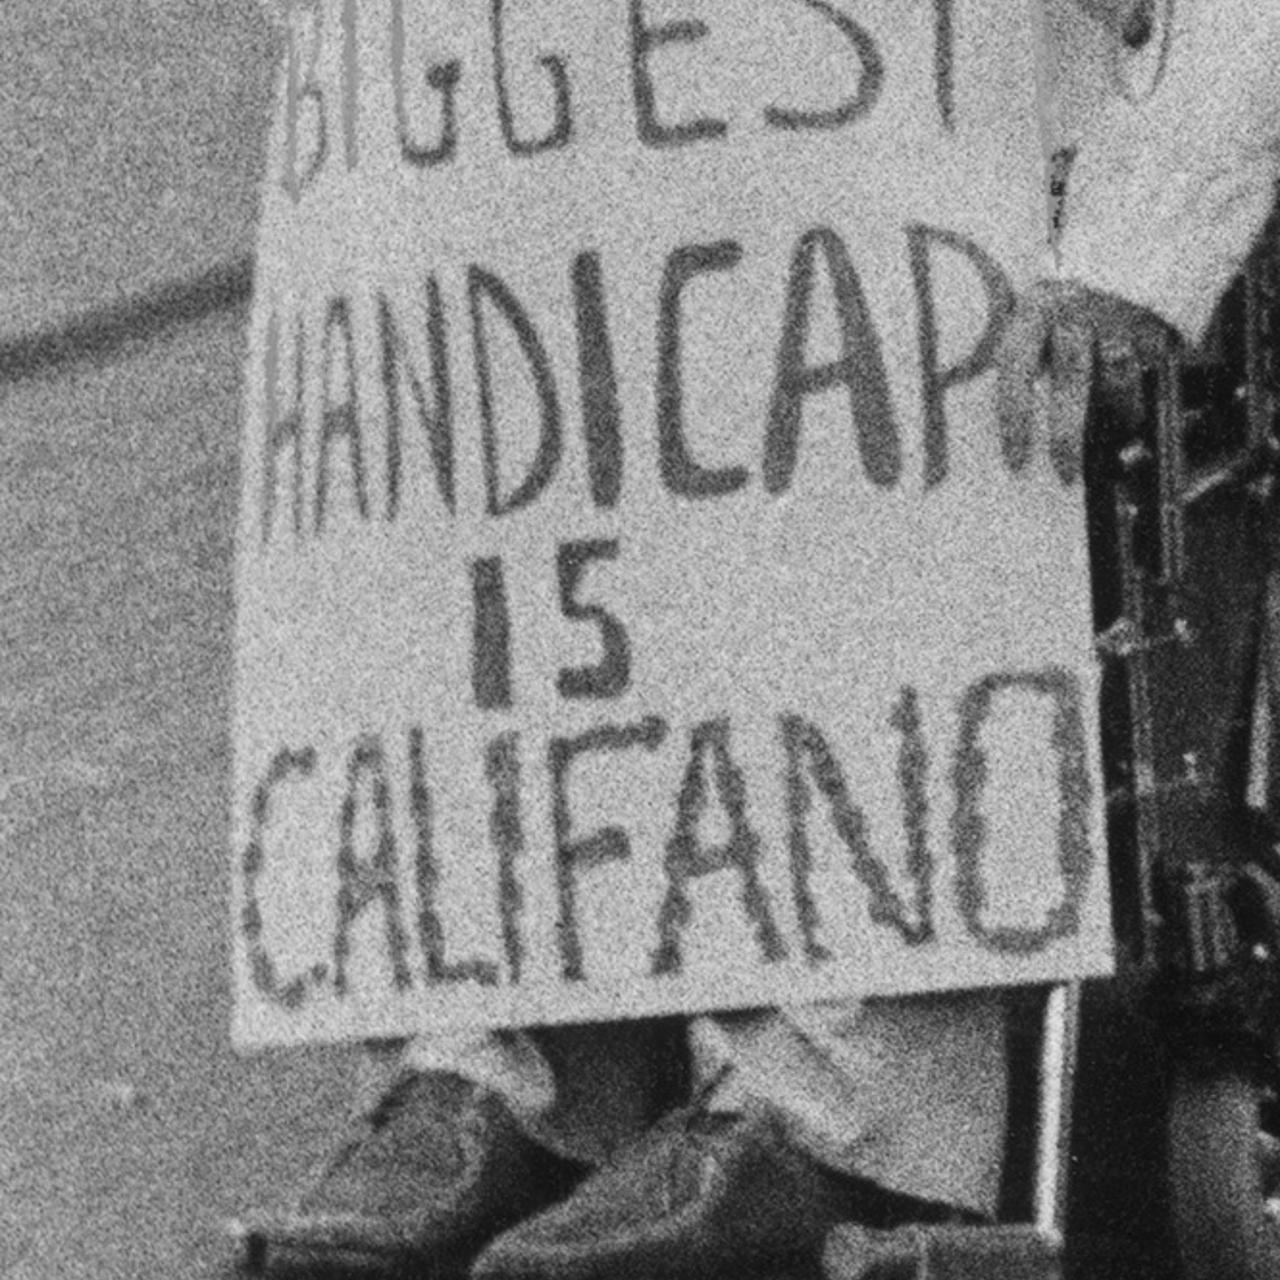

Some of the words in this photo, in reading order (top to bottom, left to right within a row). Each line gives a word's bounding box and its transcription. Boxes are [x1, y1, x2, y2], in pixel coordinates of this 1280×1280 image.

[260, 220, 1018, 552] HANDICAP
[468, 537, 633, 712] IS
[242, 664, 1093, 1007] CALIFANO
